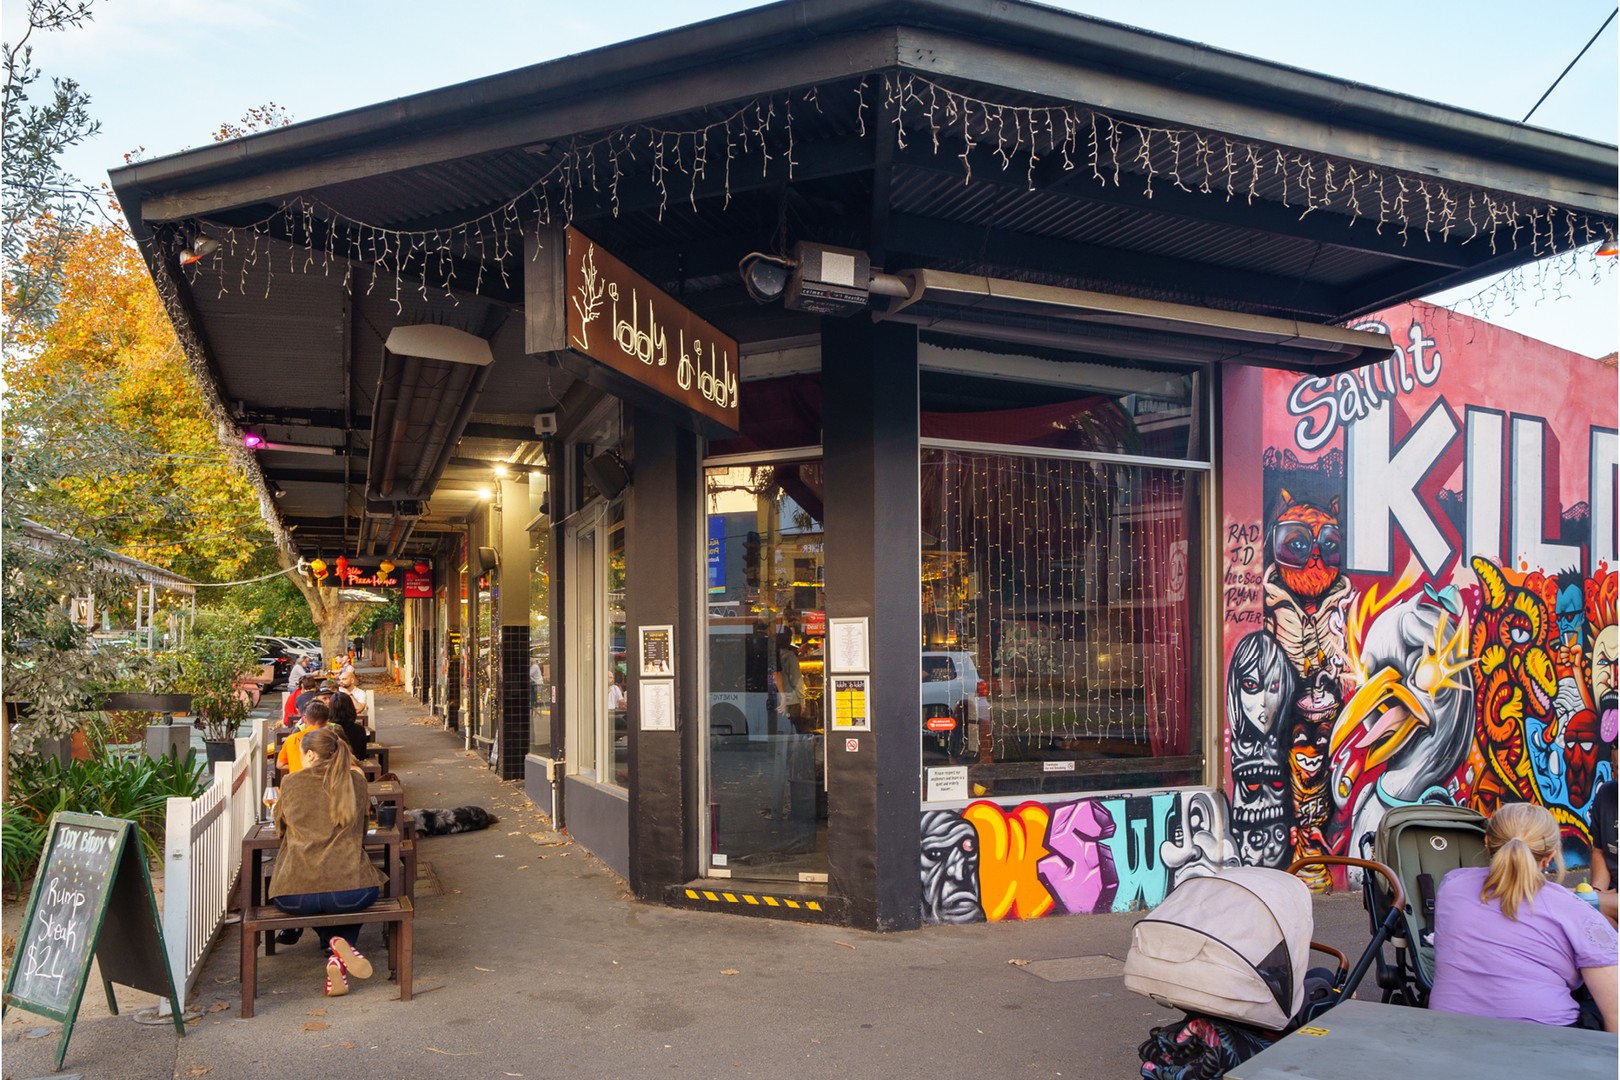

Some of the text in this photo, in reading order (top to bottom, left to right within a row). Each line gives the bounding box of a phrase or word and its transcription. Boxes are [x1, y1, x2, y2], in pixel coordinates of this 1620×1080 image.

[608, 282, 737, 408] iddy biddy
[1227, 523, 1260, 545] RAD
[1230, 546, 1255, 566] J.D
[347, 574, 373, 586] Pizza
[1224, 609, 1262, 624] FACTER
[56, 826, 82, 851] IDDY
[47, 877, 86, 919] Rump
[24, 940, 65, 997] $24
